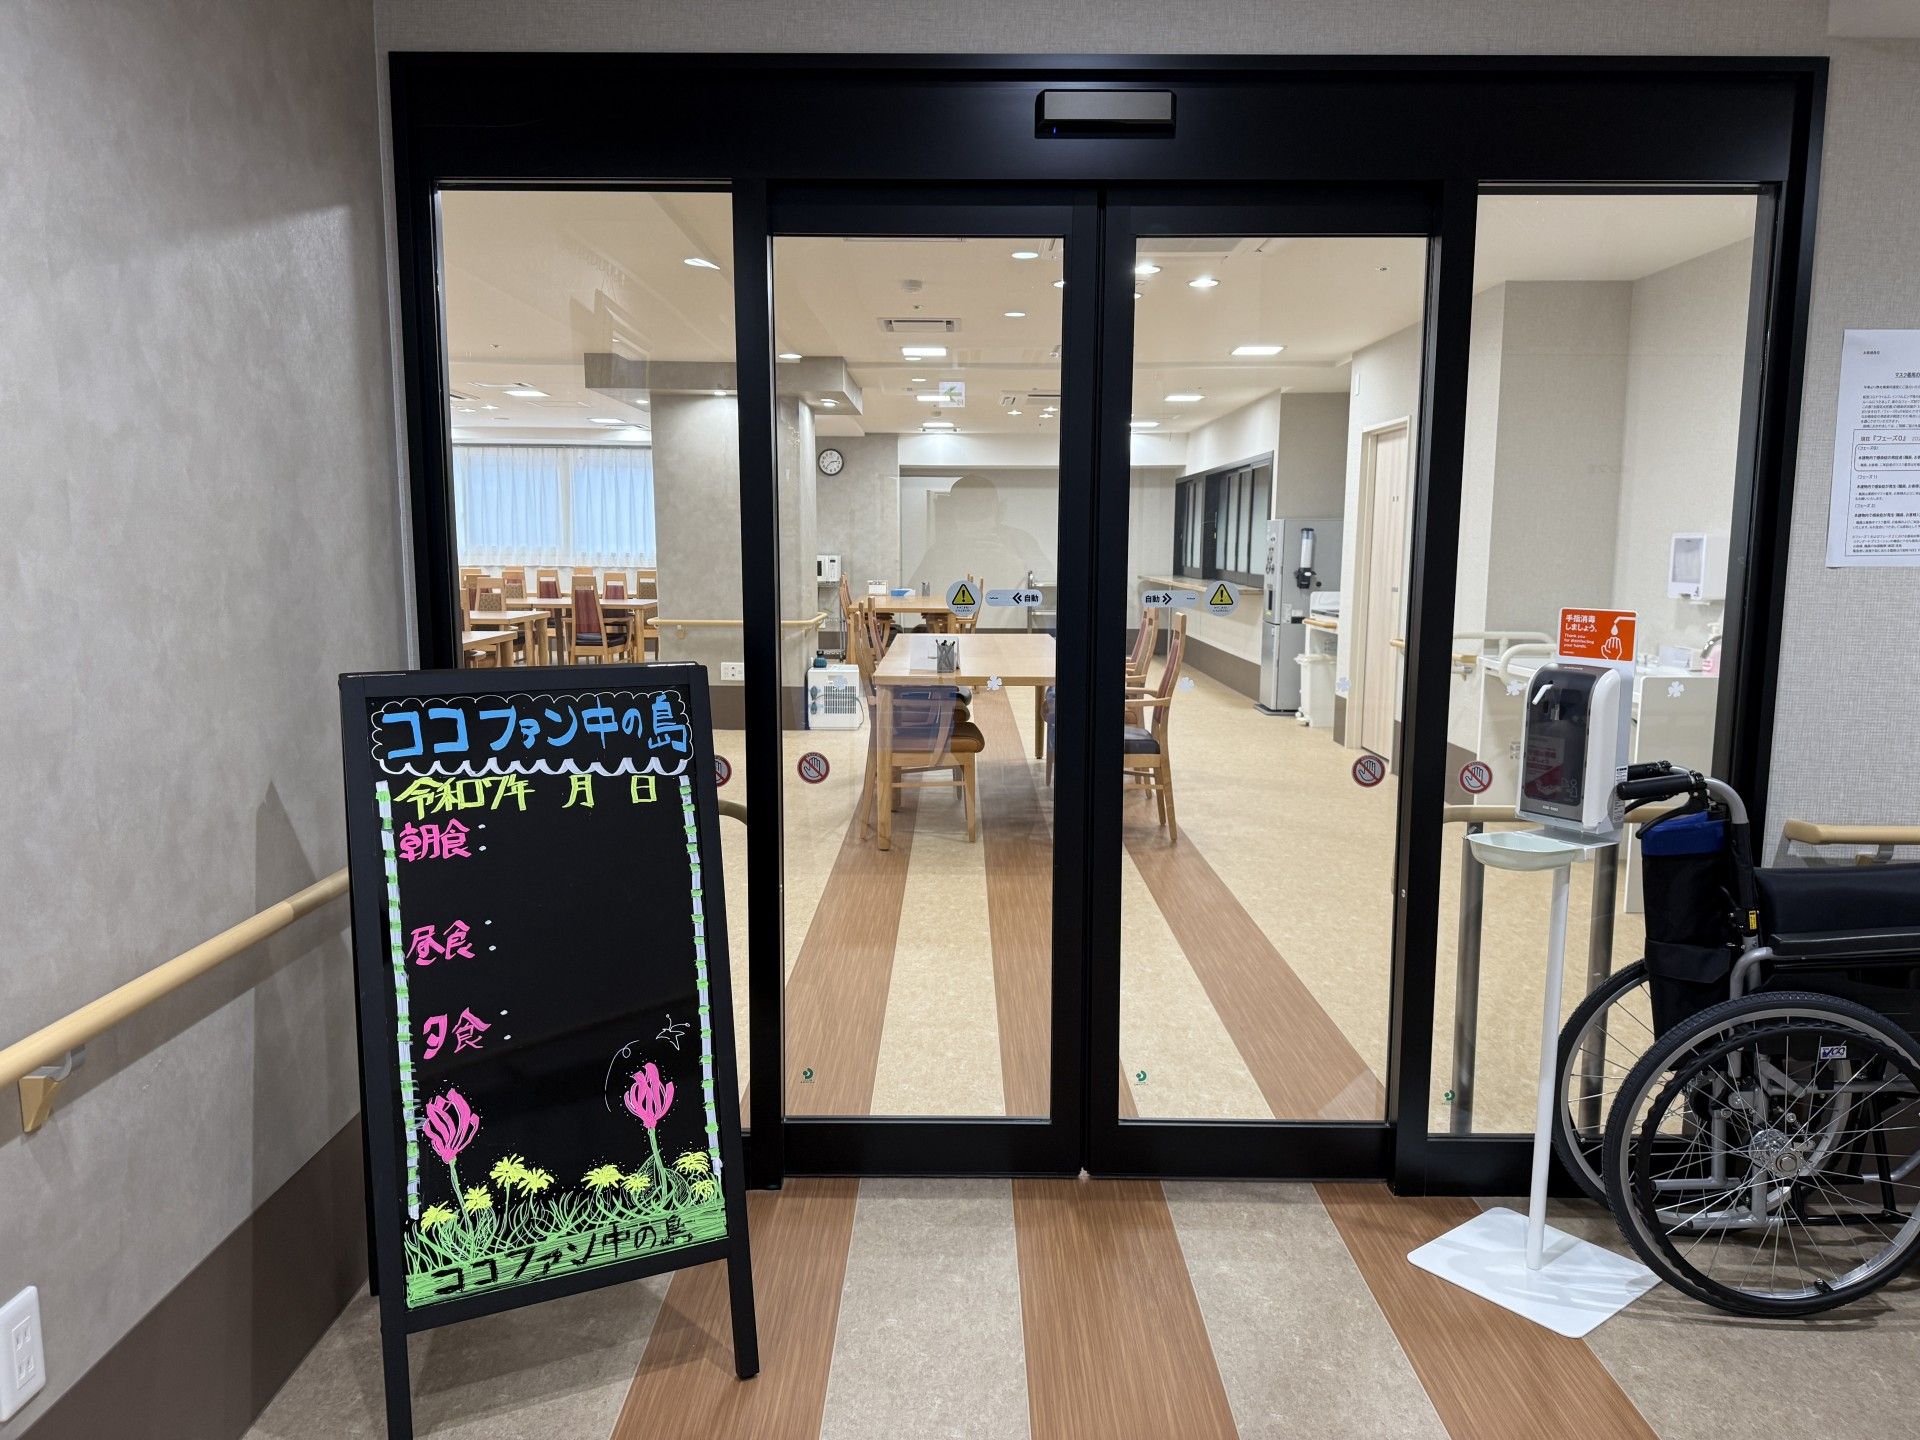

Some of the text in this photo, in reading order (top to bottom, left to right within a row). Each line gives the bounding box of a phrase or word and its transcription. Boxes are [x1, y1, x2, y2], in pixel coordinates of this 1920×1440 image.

[1024, 594, 1039, 603] 自動
[1145, 595, 1160, 604] 自動
[1565, 614, 1596, 624] 手指消毒
[382, 694, 688, 759] ココファン中の島
[562, 773, 595, 809] 月
[630, 775, 658, 804] 日
